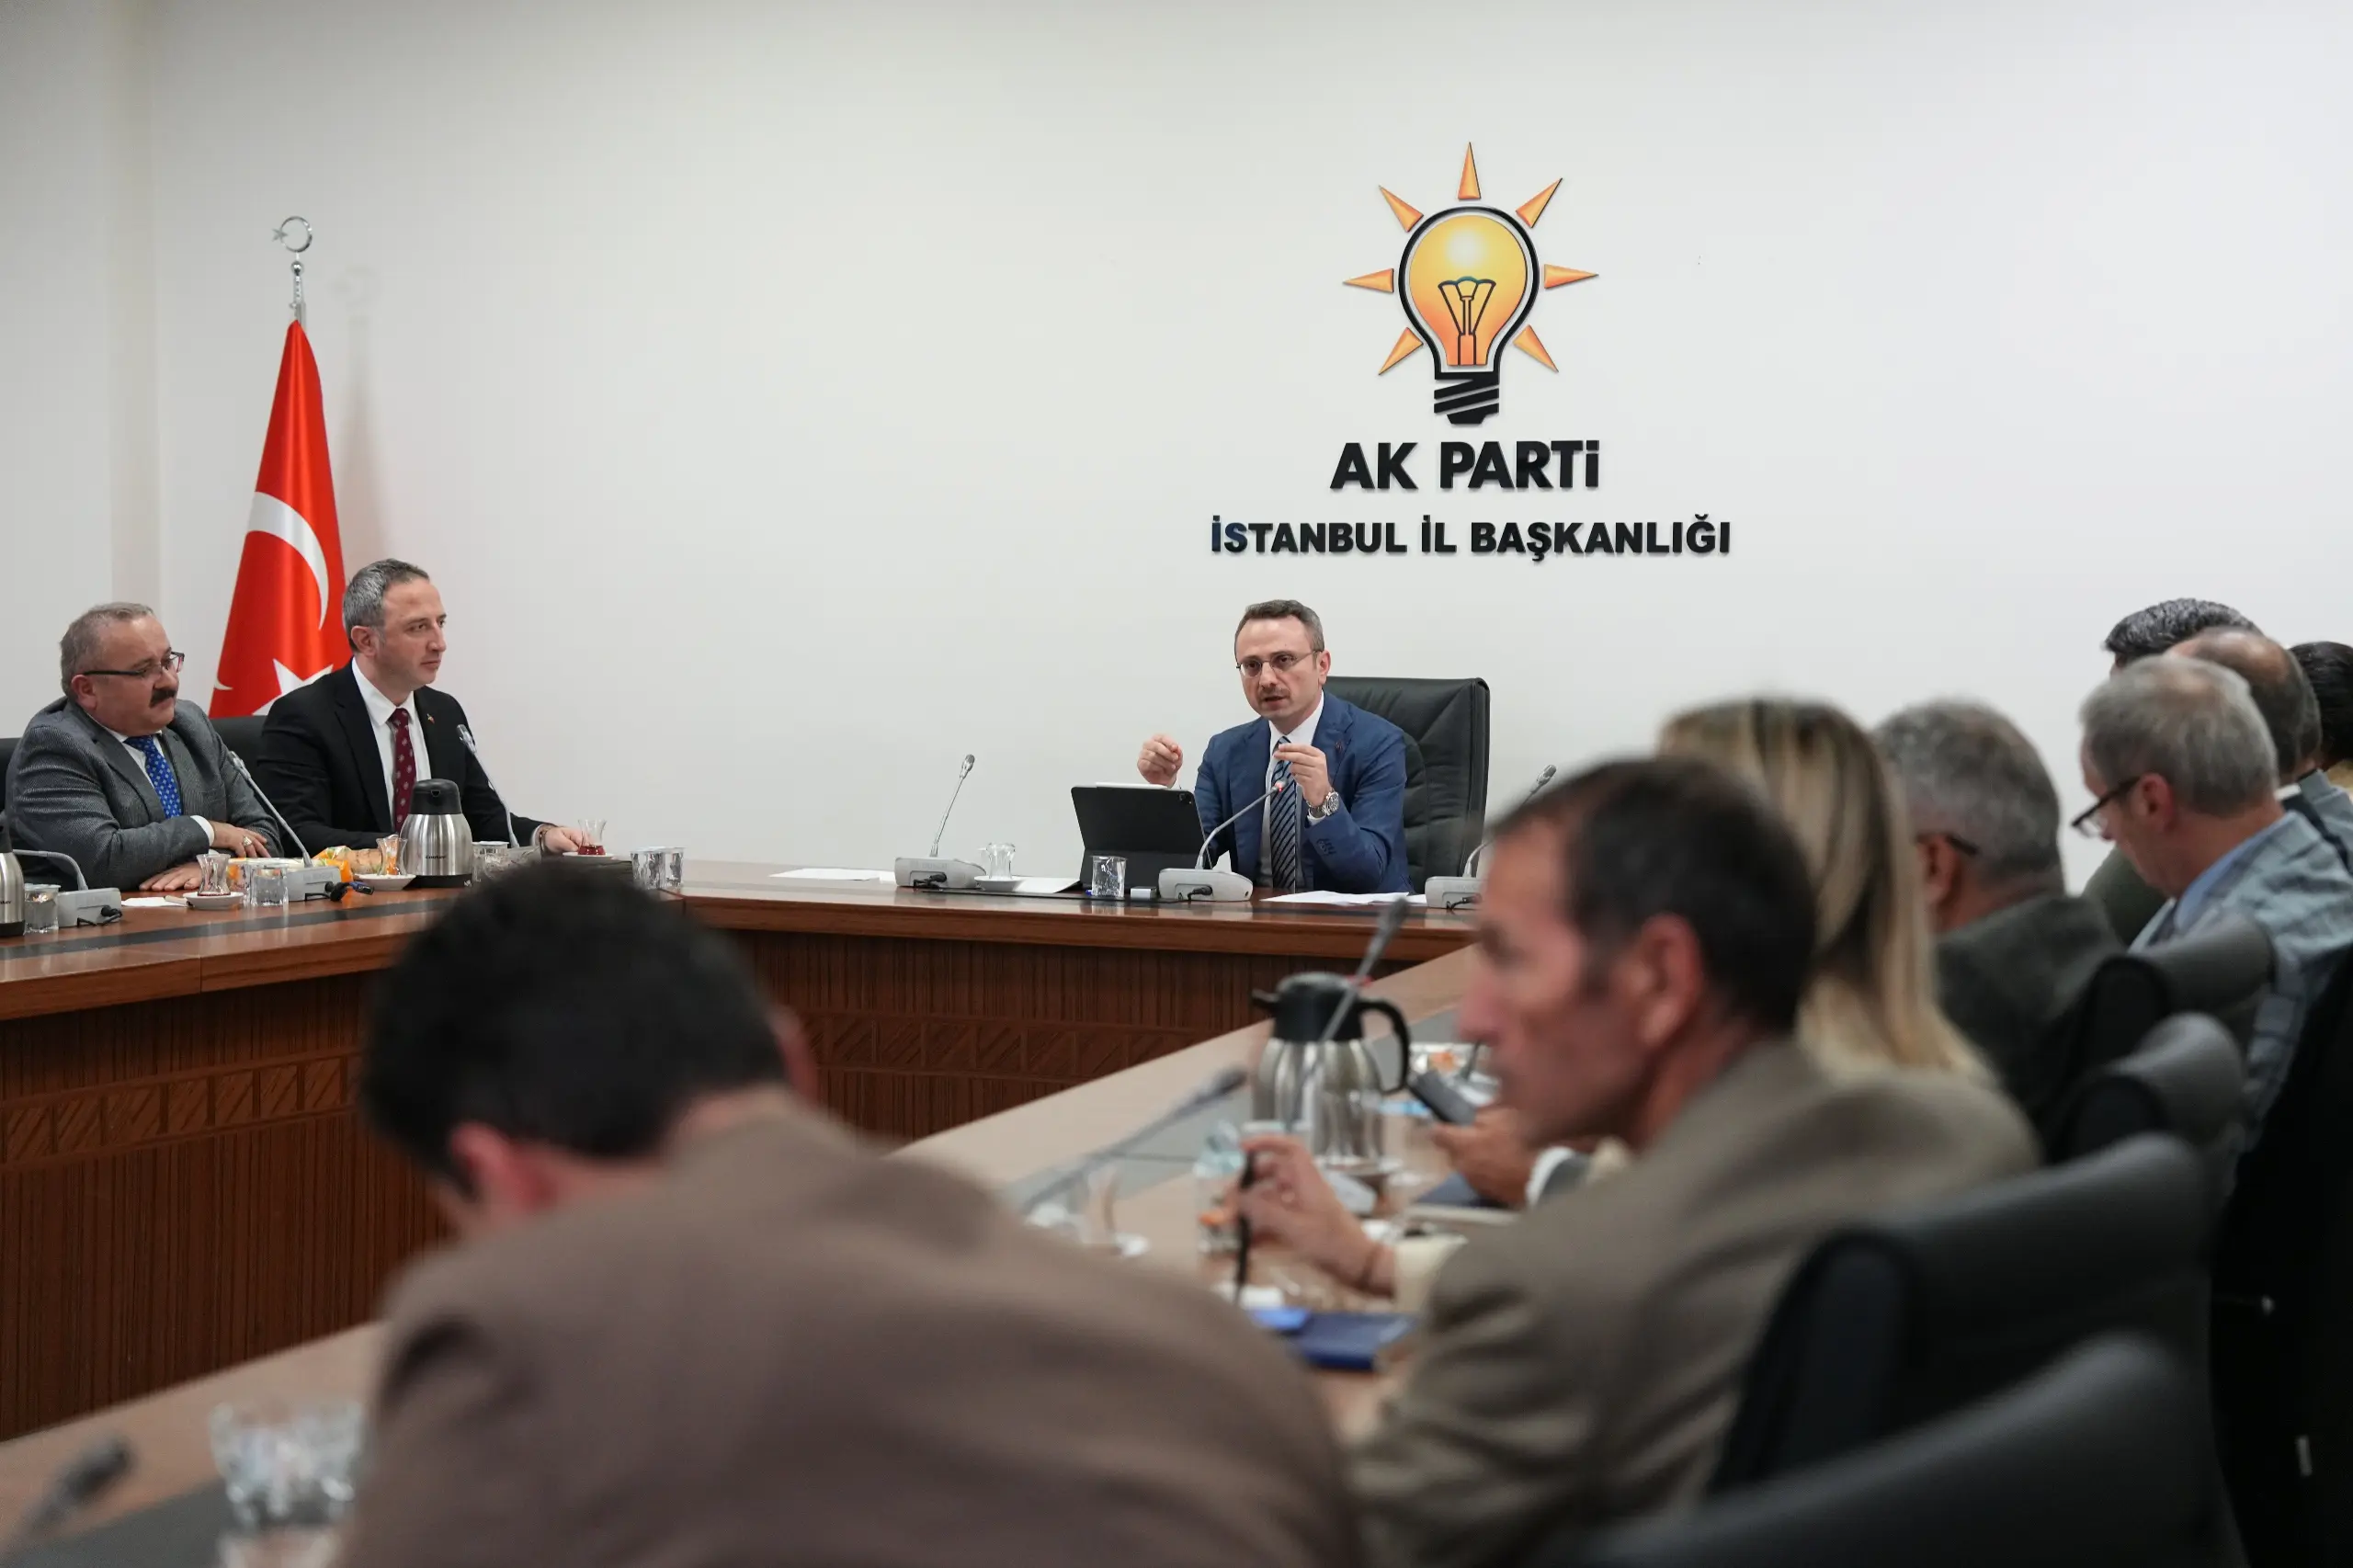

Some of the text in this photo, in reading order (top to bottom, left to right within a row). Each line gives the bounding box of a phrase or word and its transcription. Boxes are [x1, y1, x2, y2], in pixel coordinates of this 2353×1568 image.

[1329, 442, 1419, 490] AK
[1211, 513, 1731, 563] İSTANBUL İL BAŞKANLIĞI
